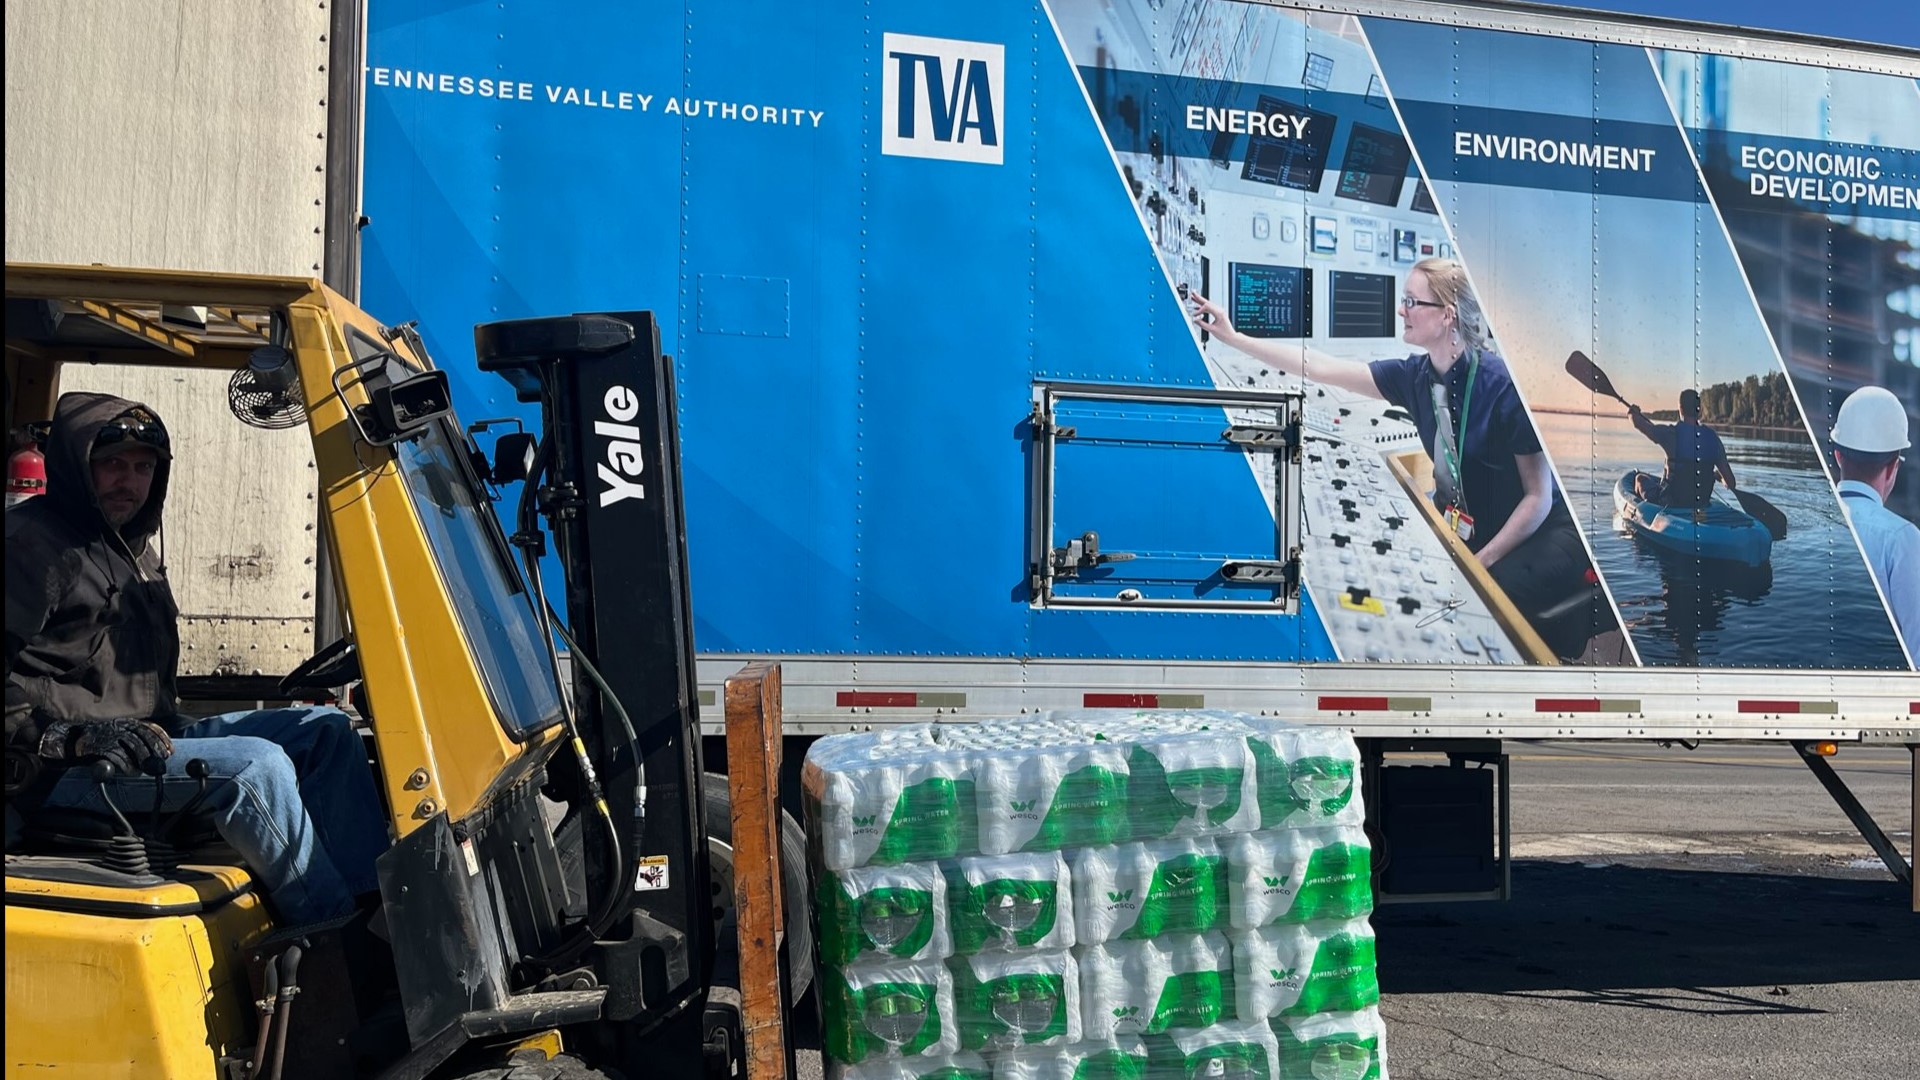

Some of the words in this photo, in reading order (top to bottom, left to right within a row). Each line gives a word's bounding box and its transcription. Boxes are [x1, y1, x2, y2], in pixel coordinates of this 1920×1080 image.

[366, 66, 534, 101] ENNESSEE
[545, 85, 654, 112] VALLEY
[664, 97, 824, 128] AUTHORITY
[889, 51, 998, 146] TVA
[1186, 105, 1311, 140] ENERGY
[1455, 131, 1656, 172] ENVIRONMENT
[1741, 146, 1881, 180] ECONOMIC
[594, 384, 645, 508] Yale
[1009, 813, 1038, 821] wesco
[1107, 902, 1136, 911] wesco
[1263, 888, 1291, 896] wesco
[1269, 981, 1298, 989] wesco
